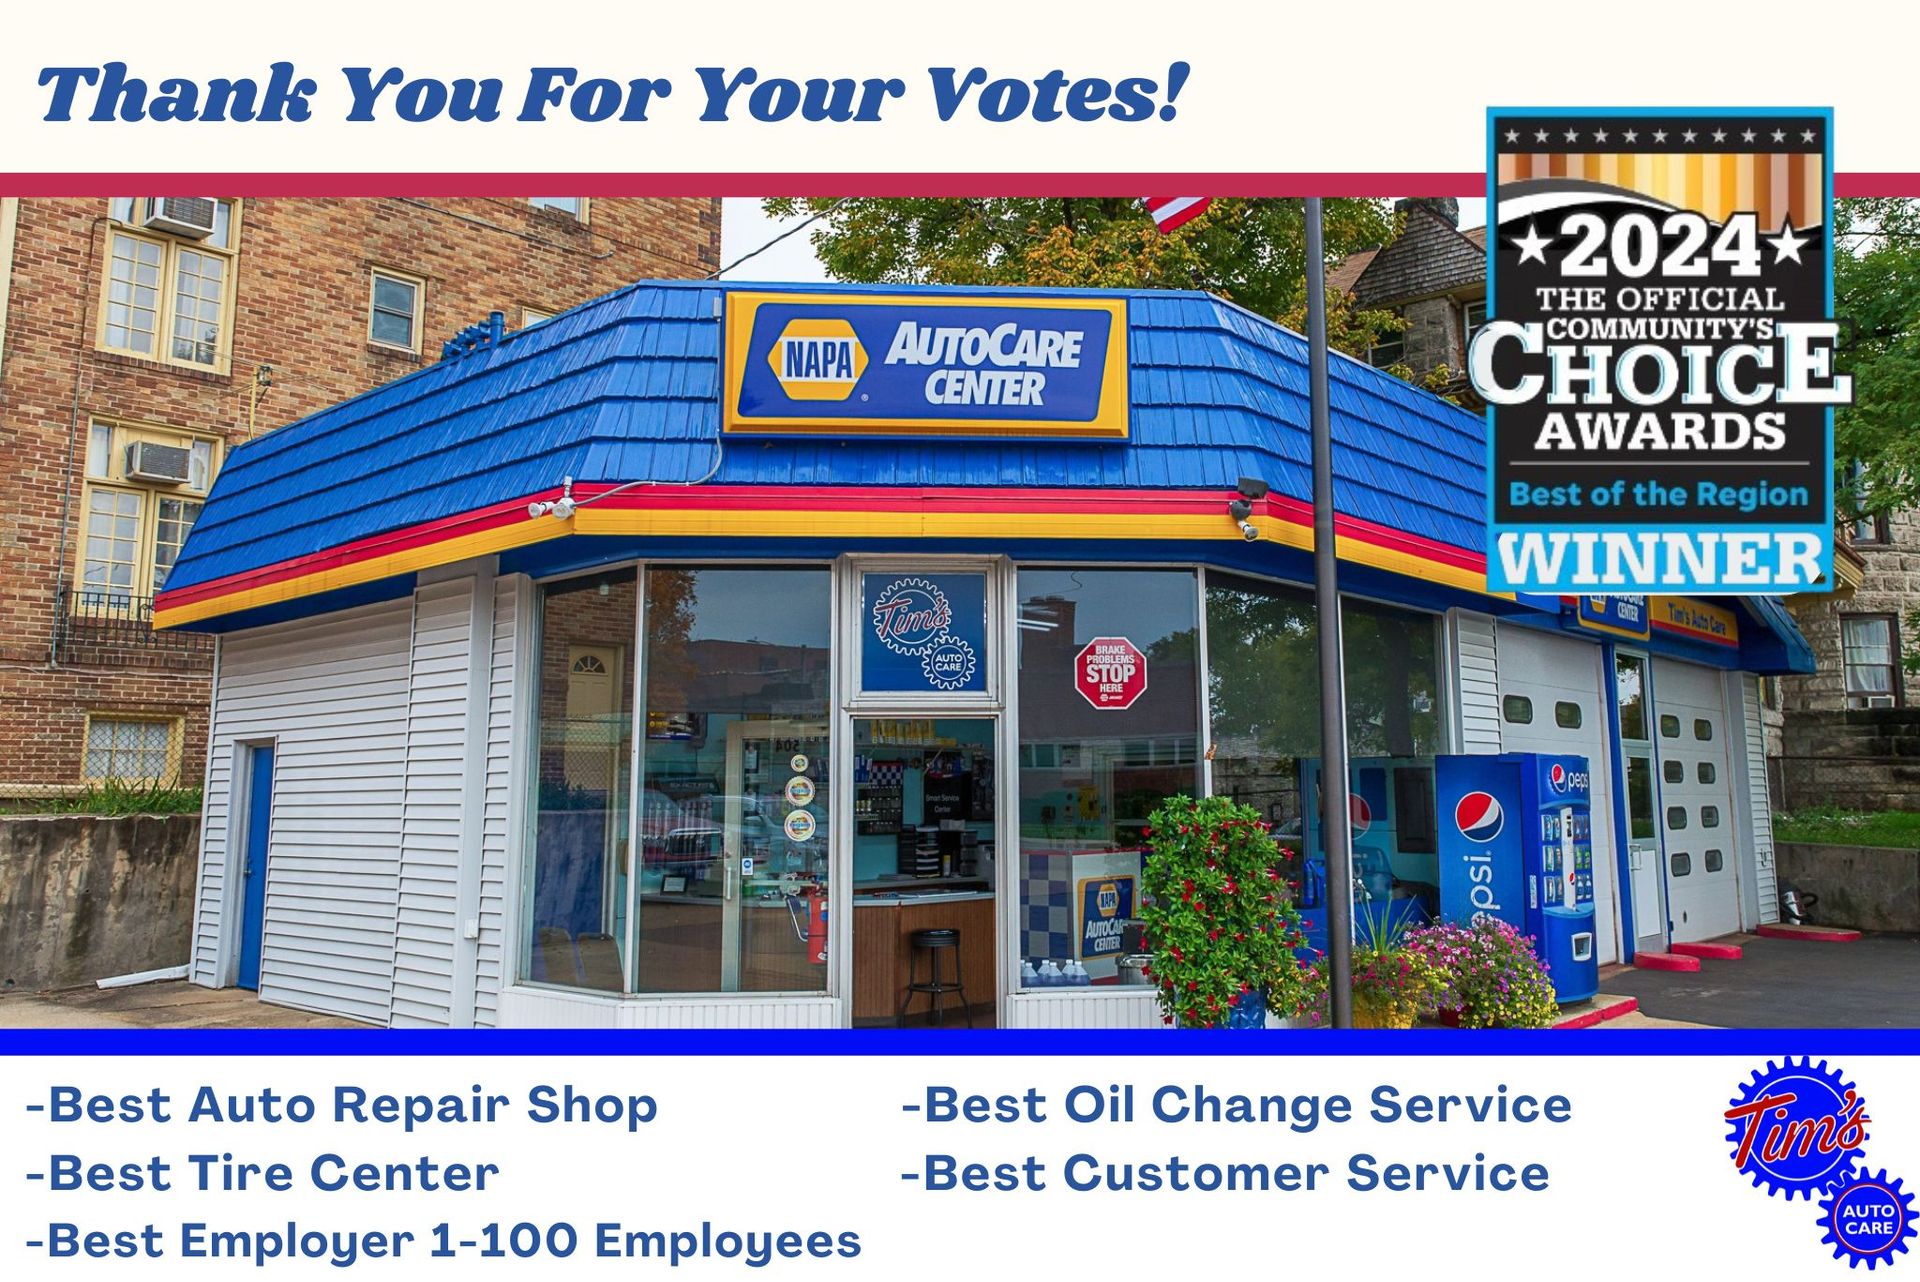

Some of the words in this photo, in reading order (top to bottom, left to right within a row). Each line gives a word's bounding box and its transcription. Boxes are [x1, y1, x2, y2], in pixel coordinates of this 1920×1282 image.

[785, 341, 853, 379] NAPA
[925, 369, 1046, 406] CENTER
[873, 597, 950, 638] Tim's
[1617, 601, 1639, 622] CENTER
[1668, 602, 1690, 625] Tim's
[1691, 609, 1709, 631] Auto
[1710, 614, 1726, 636] Care
[935, 653, 963, 662] AUTO
[1095, 645, 1126, 655] BRAKE
[935, 663, 961, 671] CARE
[1086, 655, 1134, 664] PROBLEMS
[1086, 664, 1136, 683] STOP
[1100, 683, 1123, 692] HERE
[1094, 936, 1121, 952] CENTER
